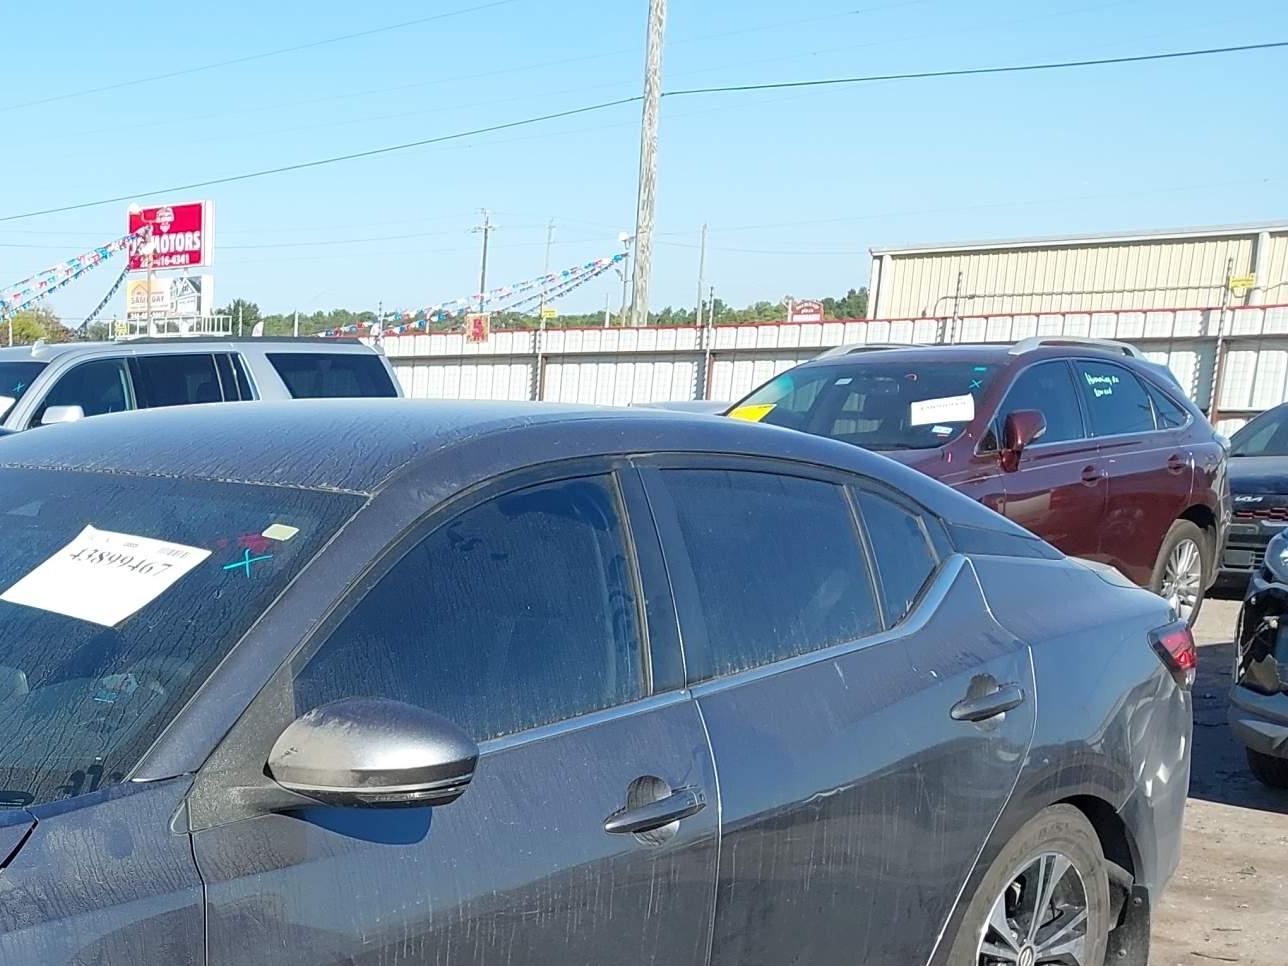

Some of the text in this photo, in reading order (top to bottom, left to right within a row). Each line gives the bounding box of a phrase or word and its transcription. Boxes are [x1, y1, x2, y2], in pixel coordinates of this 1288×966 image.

[150, 231, 200, 253] MOTORS
[130, 296, 149, 304] SAM
[69, 548, 173, 576] 43899467
